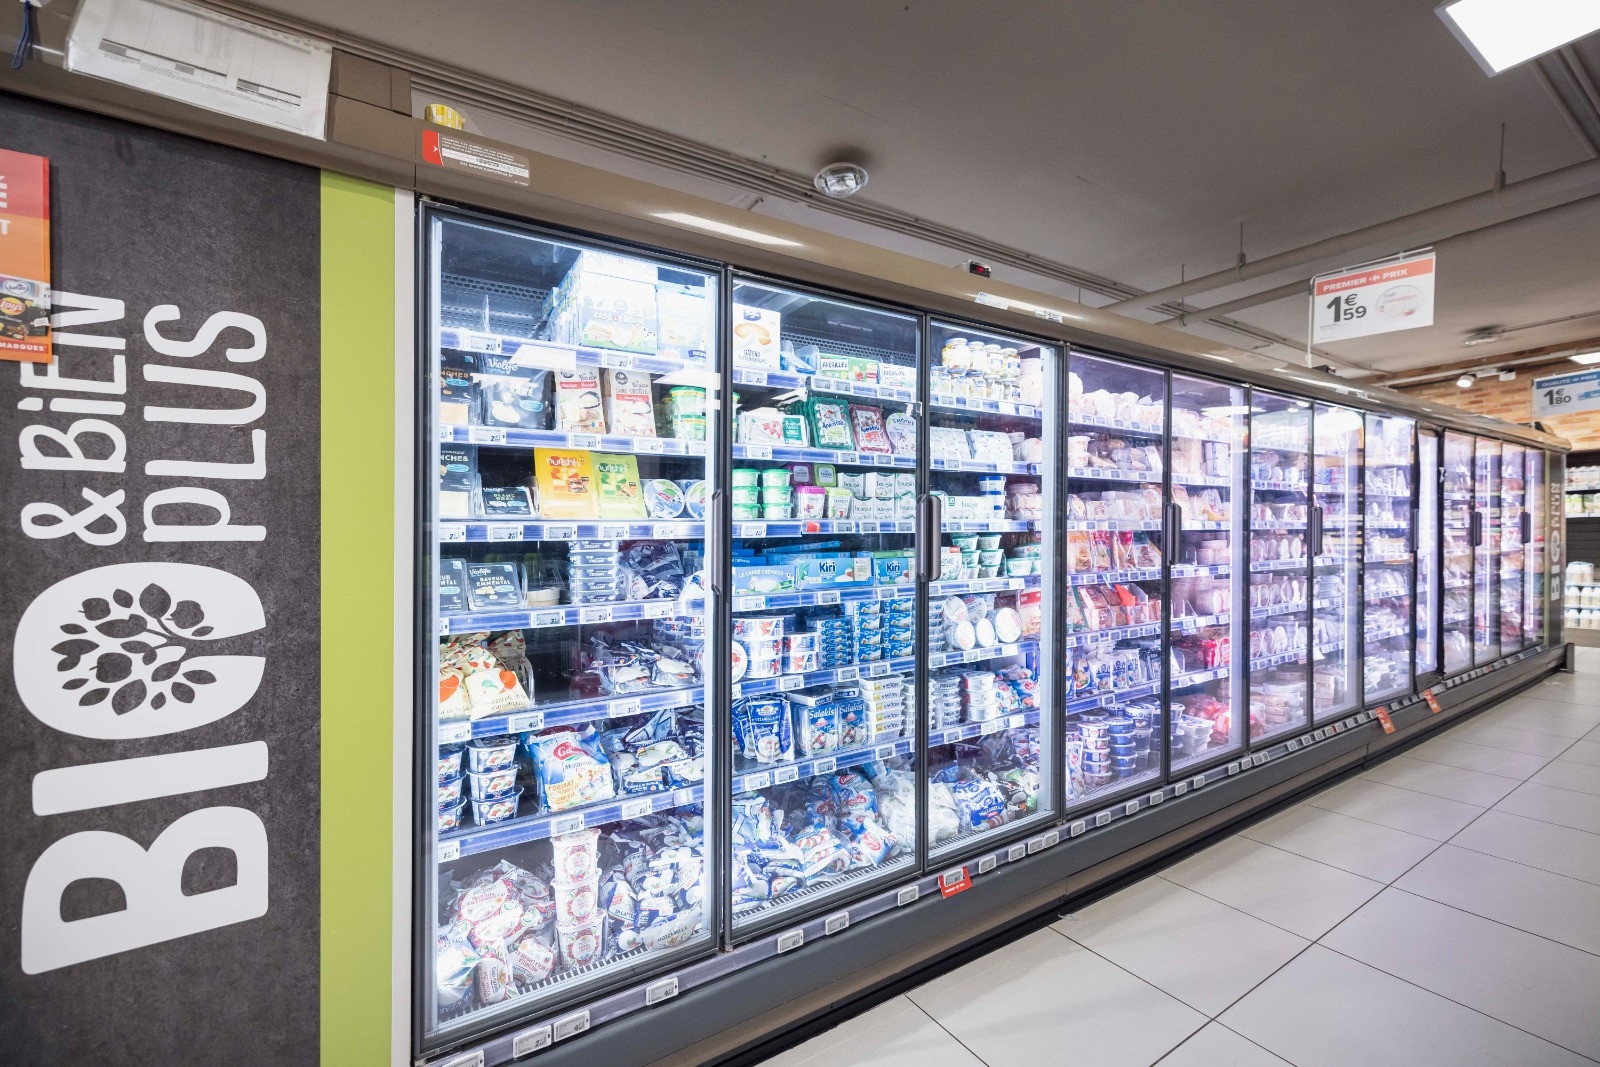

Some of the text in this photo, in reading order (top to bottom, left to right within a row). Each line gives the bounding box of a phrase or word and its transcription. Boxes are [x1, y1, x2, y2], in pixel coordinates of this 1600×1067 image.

[1323, 269, 1407, 292] PREMIER PRIX
[488, 357, 518, 374] Violife
[819, 561, 836, 573] Kiri
[886, 562, 900, 572] Kiri
[809, 707, 835, 719] Salakis
[840, 702, 863, 714] Salakis
[14, 561, 269, 975] BIO
